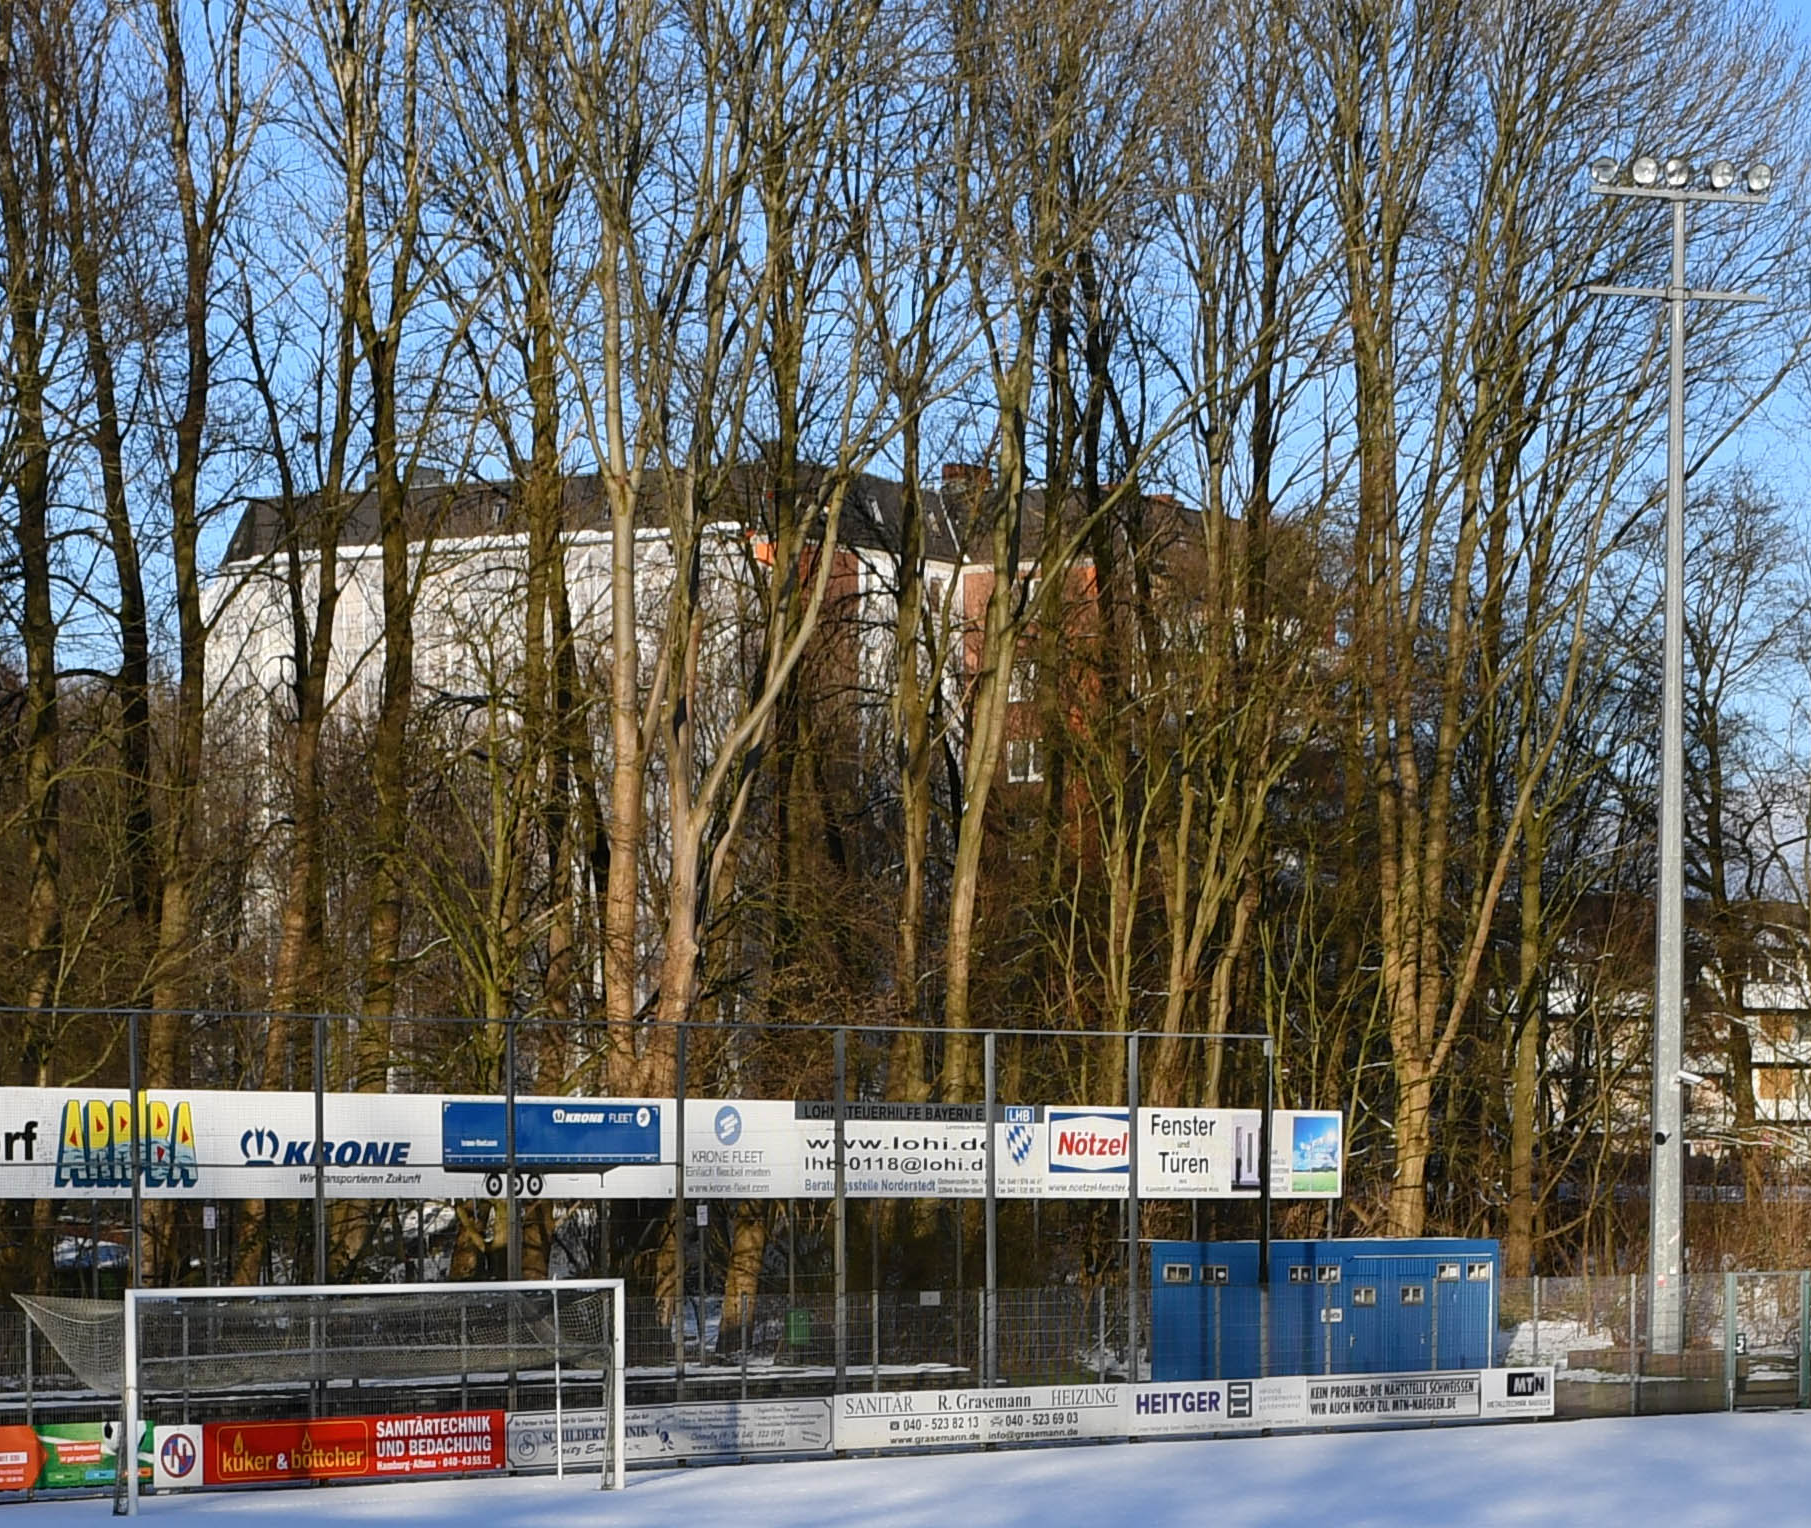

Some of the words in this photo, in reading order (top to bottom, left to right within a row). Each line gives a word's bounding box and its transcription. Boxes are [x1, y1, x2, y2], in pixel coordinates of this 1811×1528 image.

[565, 1112, 604, 1123] KRONE
[609, 1113, 633, 1123] FLEET
[926, 1106, 969, 1121] BAYERN
[1009, 1108, 1030, 1121] LHB
[1151, 1114, 1216, 1136] Fenster
[55, 1088, 198, 1188] ARRIBA
[1058, 1132, 1129, 1156] Nötzel
[283, 1141, 411, 1167] KRONE
[692, 1151, 728, 1163] KRONE
[733, 1151, 764, 1163] FLEET
[1158, 1152, 1209, 1173] Türen
[805, 1157, 984, 1175] lhb-0118@lohi.d
[386, 1174, 421, 1184] Zukunft
[805, 1179, 878, 1194] Beratusstelle
[881, 1179, 935, 1193] Norderstedt
[1048, 1183, 1130, 1193] www.noetzel-fenster.
[1310, 1386, 1328, 1399] KEIN
[1330, 1384, 1369, 1398] PROBLEM:
[1371, 1384, 1383, 1396] DIE
[1384, 1382, 1428, 1396] NAHTSTELLE
[1430, 1380, 1474, 1394] SCHWEISSEN
[1514, 1376, 1545, 1393] MTN
[846, 1391, 913, 1414] SANITÄR
[938, 1394, 953, 1411] R.
[956, 1393, 1031, 1409] Grasemann
[1051, 1387, 1117, 1406] HEIZUNG
[1136, 1391, 1221, 1415] HEITGER
[1310, 1401, 1327, 1415] WIR
[1330, 1401, 1351, 1415] AUCH
[1353, 1399, 1375, 1413] NOCH
[1392, 1397, 1456, 1412] MTN-NAEGLER.DE
[376, 1414, 490, 1438] SANITÄRTECHNIK
[903, 1417, 922, 1431] 040
[932, 1417, 949, 1430] 523
[952, 1416, 965, 1429] 82
[967, 1415, 980, 1428] 13
[1005, 1414, 1023, 1428] 040
[1033, 1413, 1050, 1427] 523
[1052, 1412, 1065, 1425] 69
[1067, 1411, 1079, 1425] 03
[890, 1433, 981, 1445] www.grasemann.de
[989, 1428, 1078, 1441] info@grasemann.de
[376, 1439, 405, 1457] UND
[409, 1436, 491, 1455] BEDACHUNG
[277, 1453, 288, 1470] &
